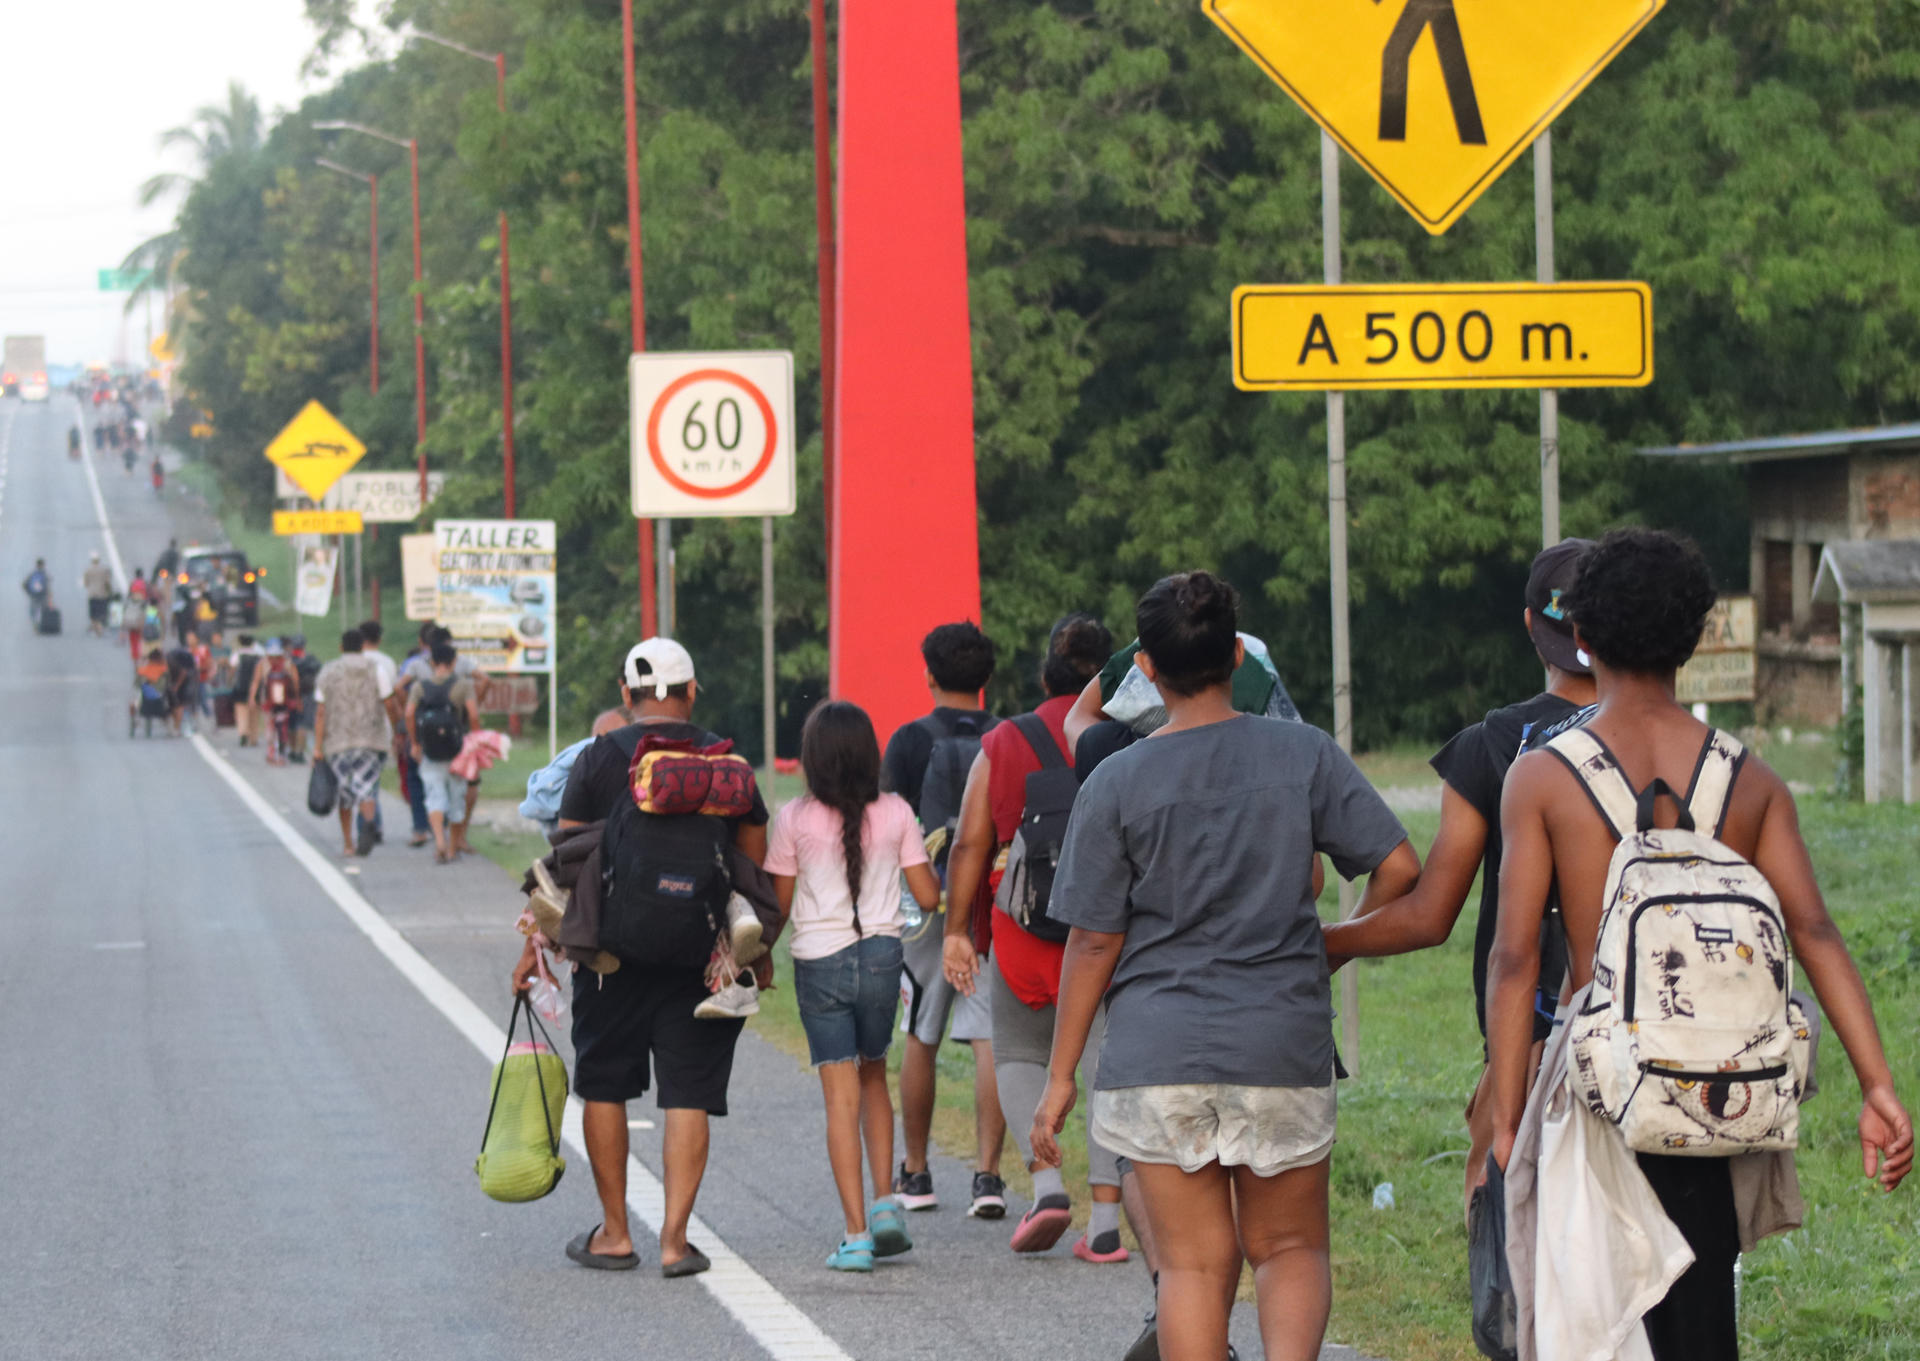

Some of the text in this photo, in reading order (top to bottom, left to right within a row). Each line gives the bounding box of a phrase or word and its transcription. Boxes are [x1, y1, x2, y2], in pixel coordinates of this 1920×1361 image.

[1297, 310, 1588, 366] A 500 m.
[682, 397, 742, 452] 60
[682, 459, 742, 472] km/h
[442, 527, 542, 549] TALLER
